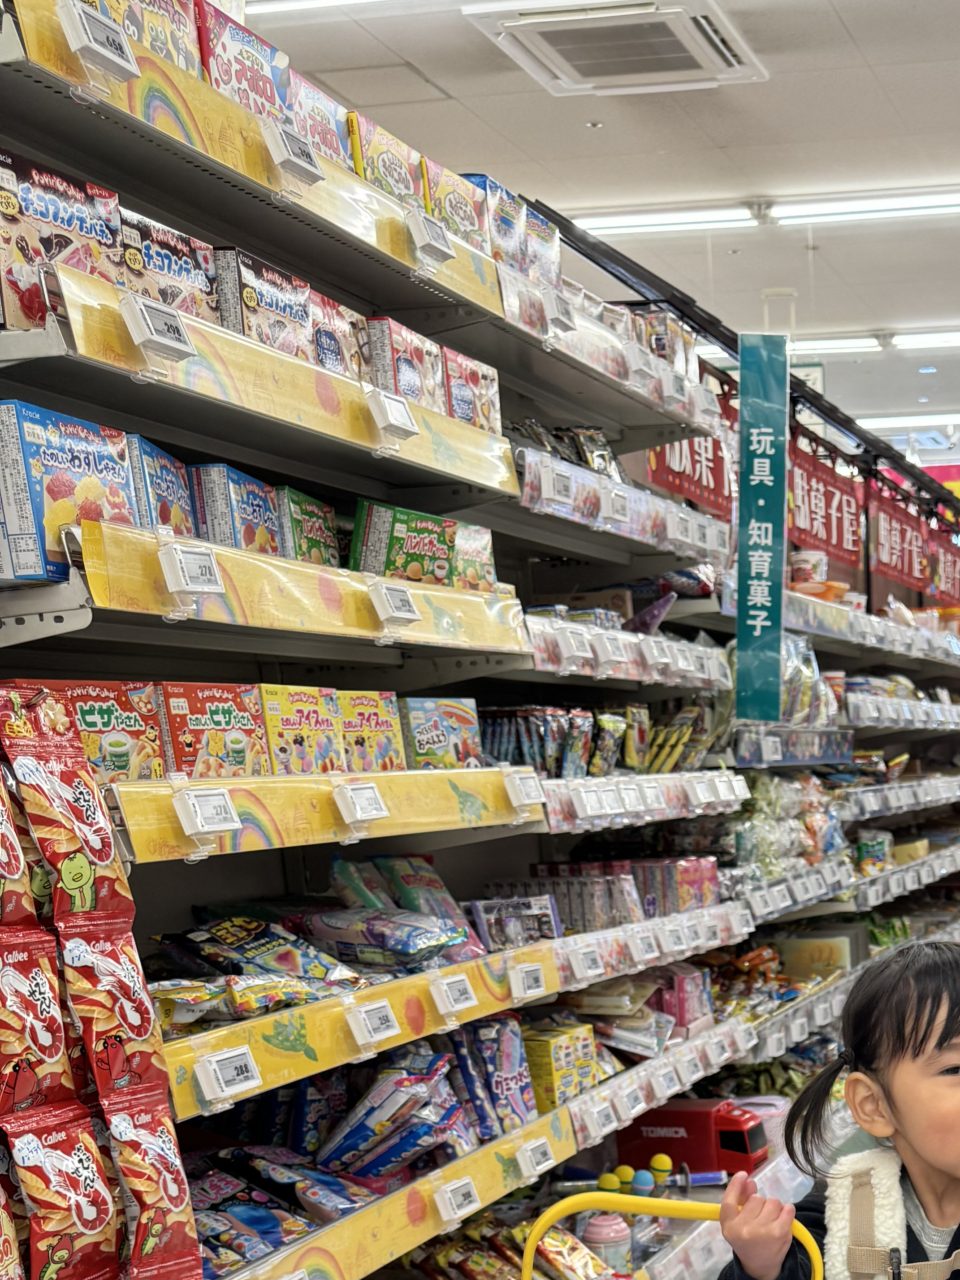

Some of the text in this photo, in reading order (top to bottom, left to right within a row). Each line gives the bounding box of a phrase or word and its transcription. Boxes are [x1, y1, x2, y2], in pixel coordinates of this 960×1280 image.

[234, 56, 275, 106] アポロ
[793, 466, 859, 551] 駄菓子屋
[746, 427, 776, 637] 玩具・知育菓子
[188, 703, 254, 728] たのしいピザやさん
[4, 951, 28, 964] Calbee
[234, 1063, 250, 1078] 288
[41, 1130, 68, 1147] Calbee
[641, 1126, 688, 1138] TOMICA
